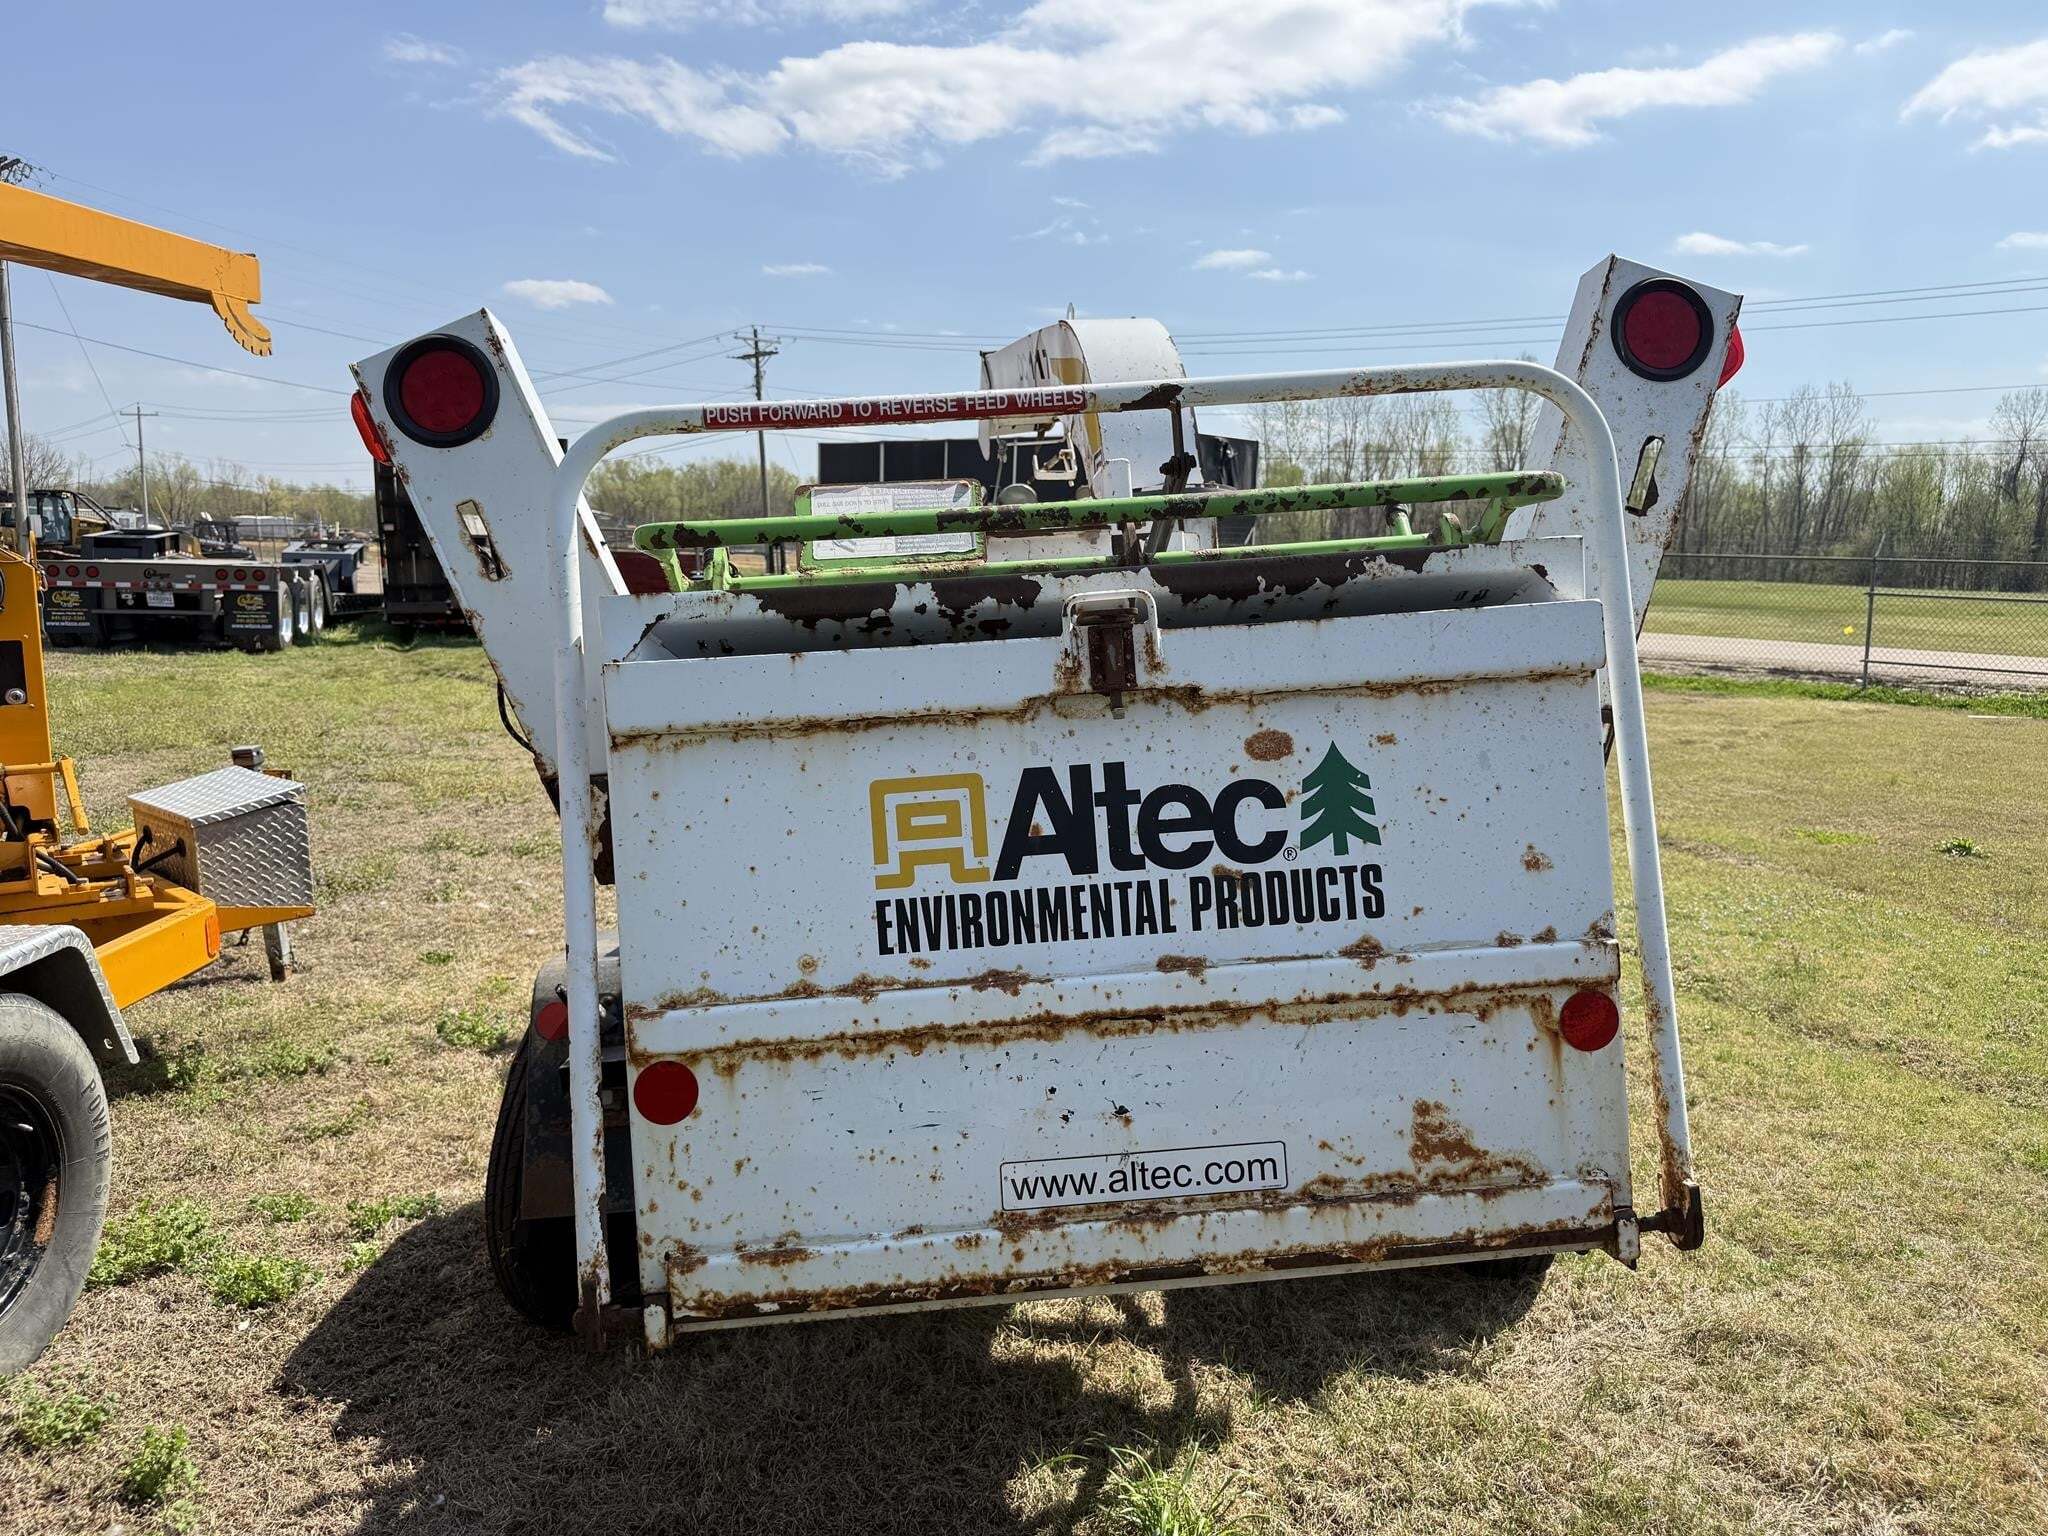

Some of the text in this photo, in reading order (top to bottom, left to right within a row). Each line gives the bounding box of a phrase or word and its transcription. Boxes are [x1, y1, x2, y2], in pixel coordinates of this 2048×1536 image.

[705, 390, 1083, 424] PUSH FORWARD TO REVERSE FEED WHEELS
[993, 761, 1289, 881] Altec
[875, 863, 1386, 956] ENVIRONMENTAL PRODUCTS
[80, 1078, 110, 1163] POWER
[1010, 1156, 1278, 1201] www.altec.com
